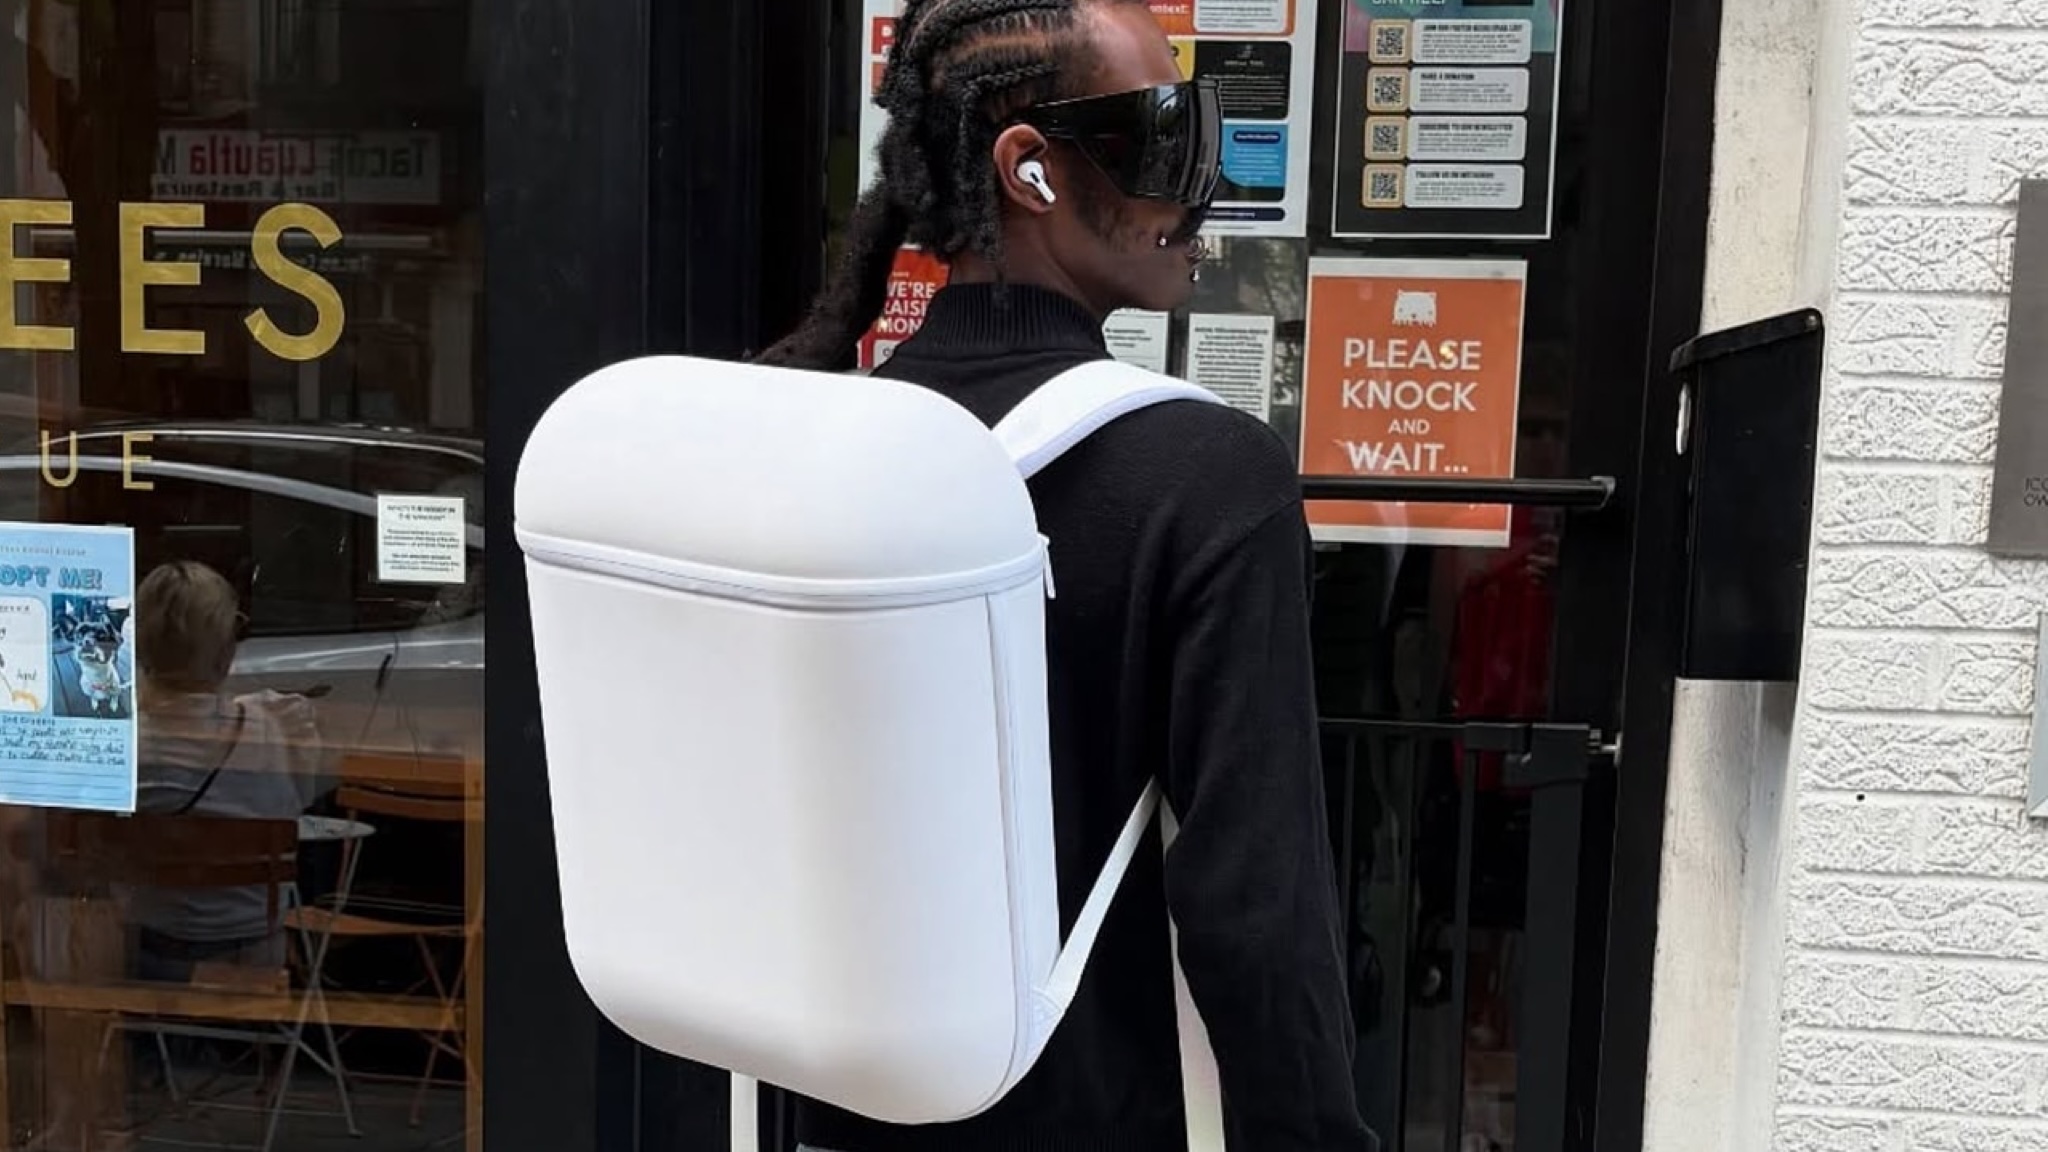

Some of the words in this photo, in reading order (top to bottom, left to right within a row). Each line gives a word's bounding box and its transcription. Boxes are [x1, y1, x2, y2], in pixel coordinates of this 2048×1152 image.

[1344, 338, 1482, 371] PLEASE
[1342, 379, 1478, 411] KNOCK
[1388, 419, 1431, 435] AND
[1347, 442, 1469, 474] WAIT...
